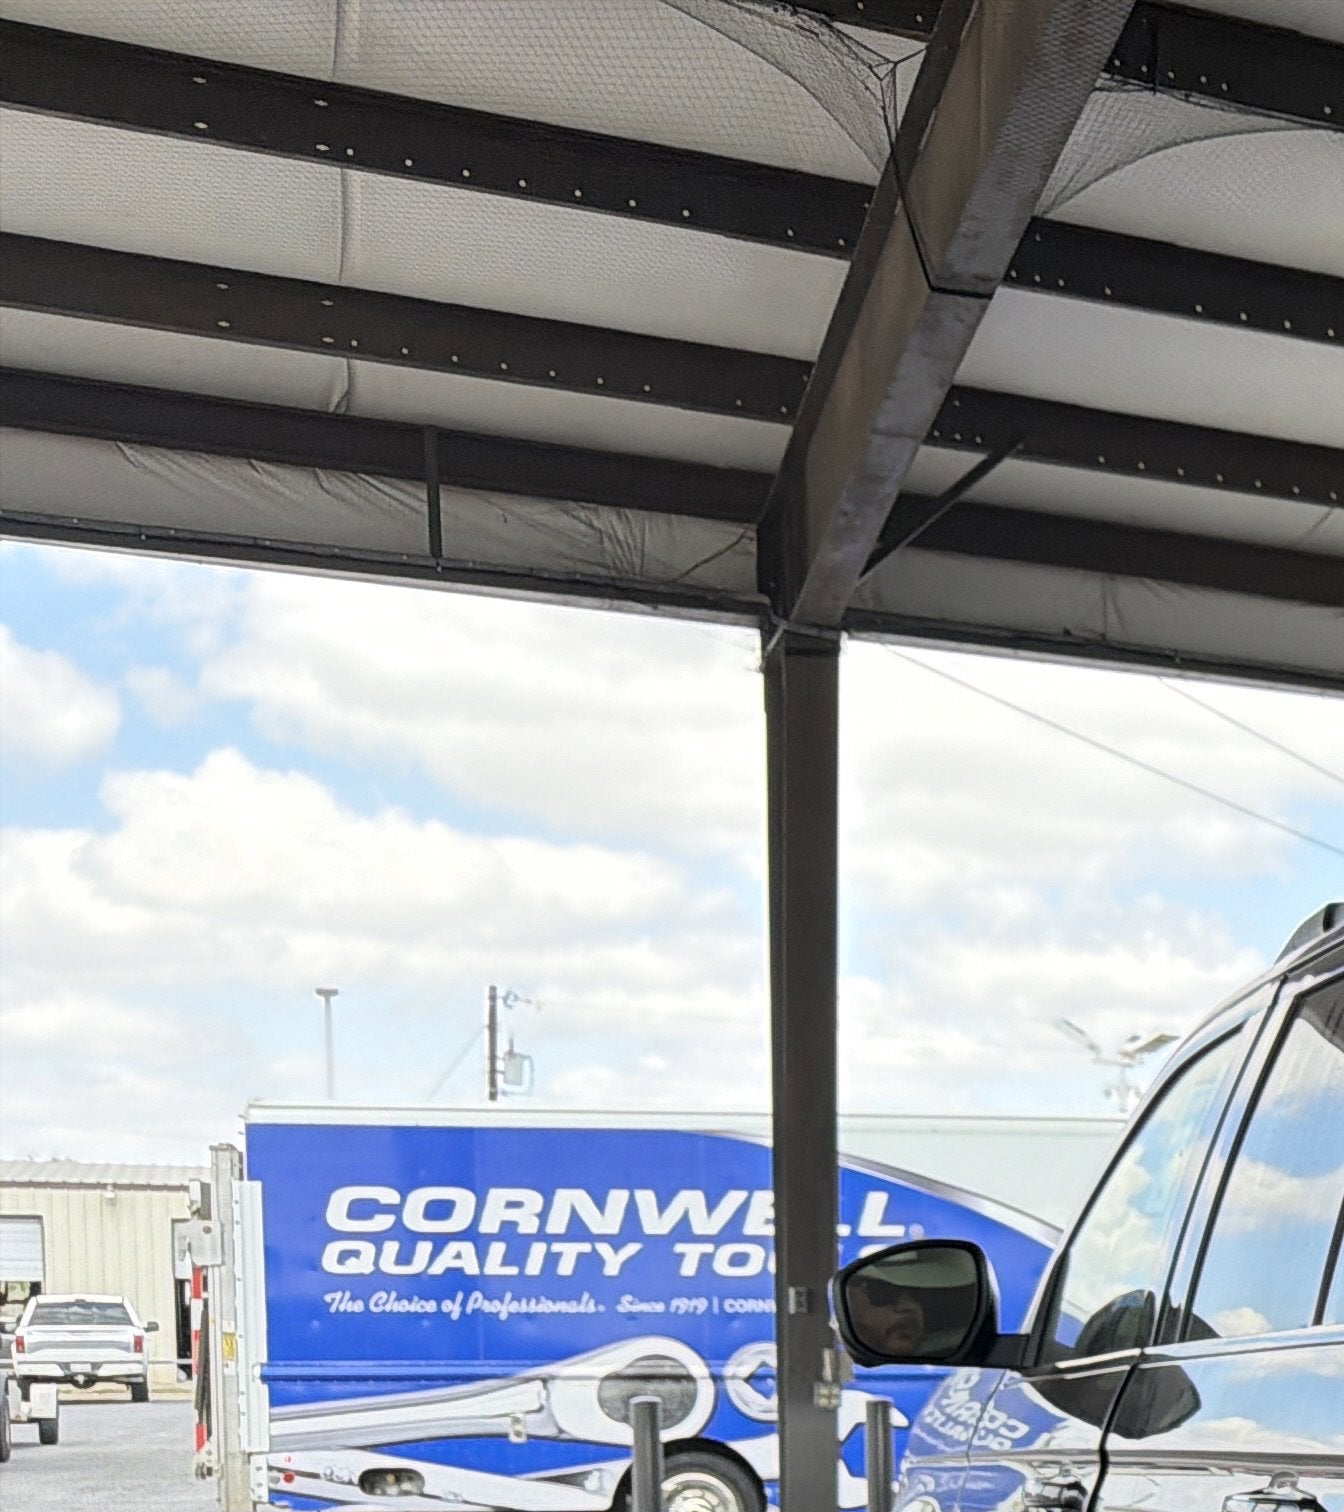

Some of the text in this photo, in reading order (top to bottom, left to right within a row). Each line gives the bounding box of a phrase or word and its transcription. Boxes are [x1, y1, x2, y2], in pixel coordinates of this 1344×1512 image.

[321, 1240, 644, 1277] QUALITY
[323, 1290, 364, 1313] The
[368, 1291, 437, 1314] Choice
[440, 1290, 463, 1320] of
[617, 1294, 665, 1314] Since
[669, 1295, 709, 1316] 1919
